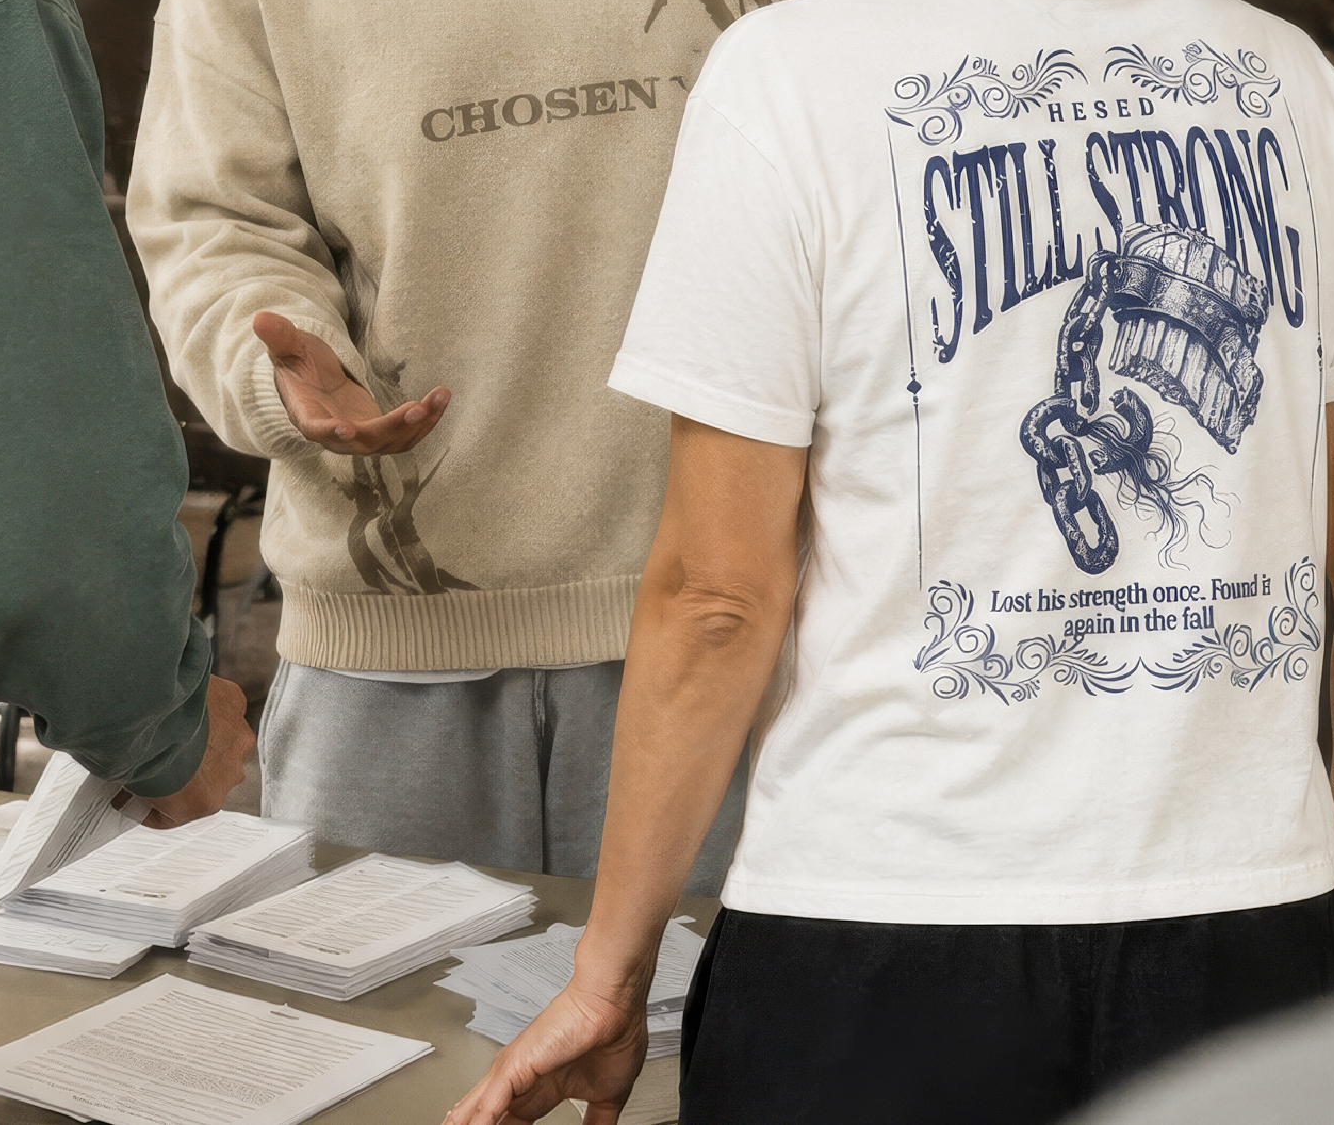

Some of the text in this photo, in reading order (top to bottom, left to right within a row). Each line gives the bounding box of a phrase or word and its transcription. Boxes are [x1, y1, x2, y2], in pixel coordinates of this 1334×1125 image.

[421, 77, 660, 142] CHOSEN
[1048, 97, 1157, 123] HESED
[923, 126, 1305, 364] STILL STRONG
[990, 590, 1032, 613] Lost
[1037, 588, 1066, 612] his
[1068, 582, 1148, 612] strength
[1211, 573, 1258, 600] Found
[1064, 605, 1215, 641] again in the fall
